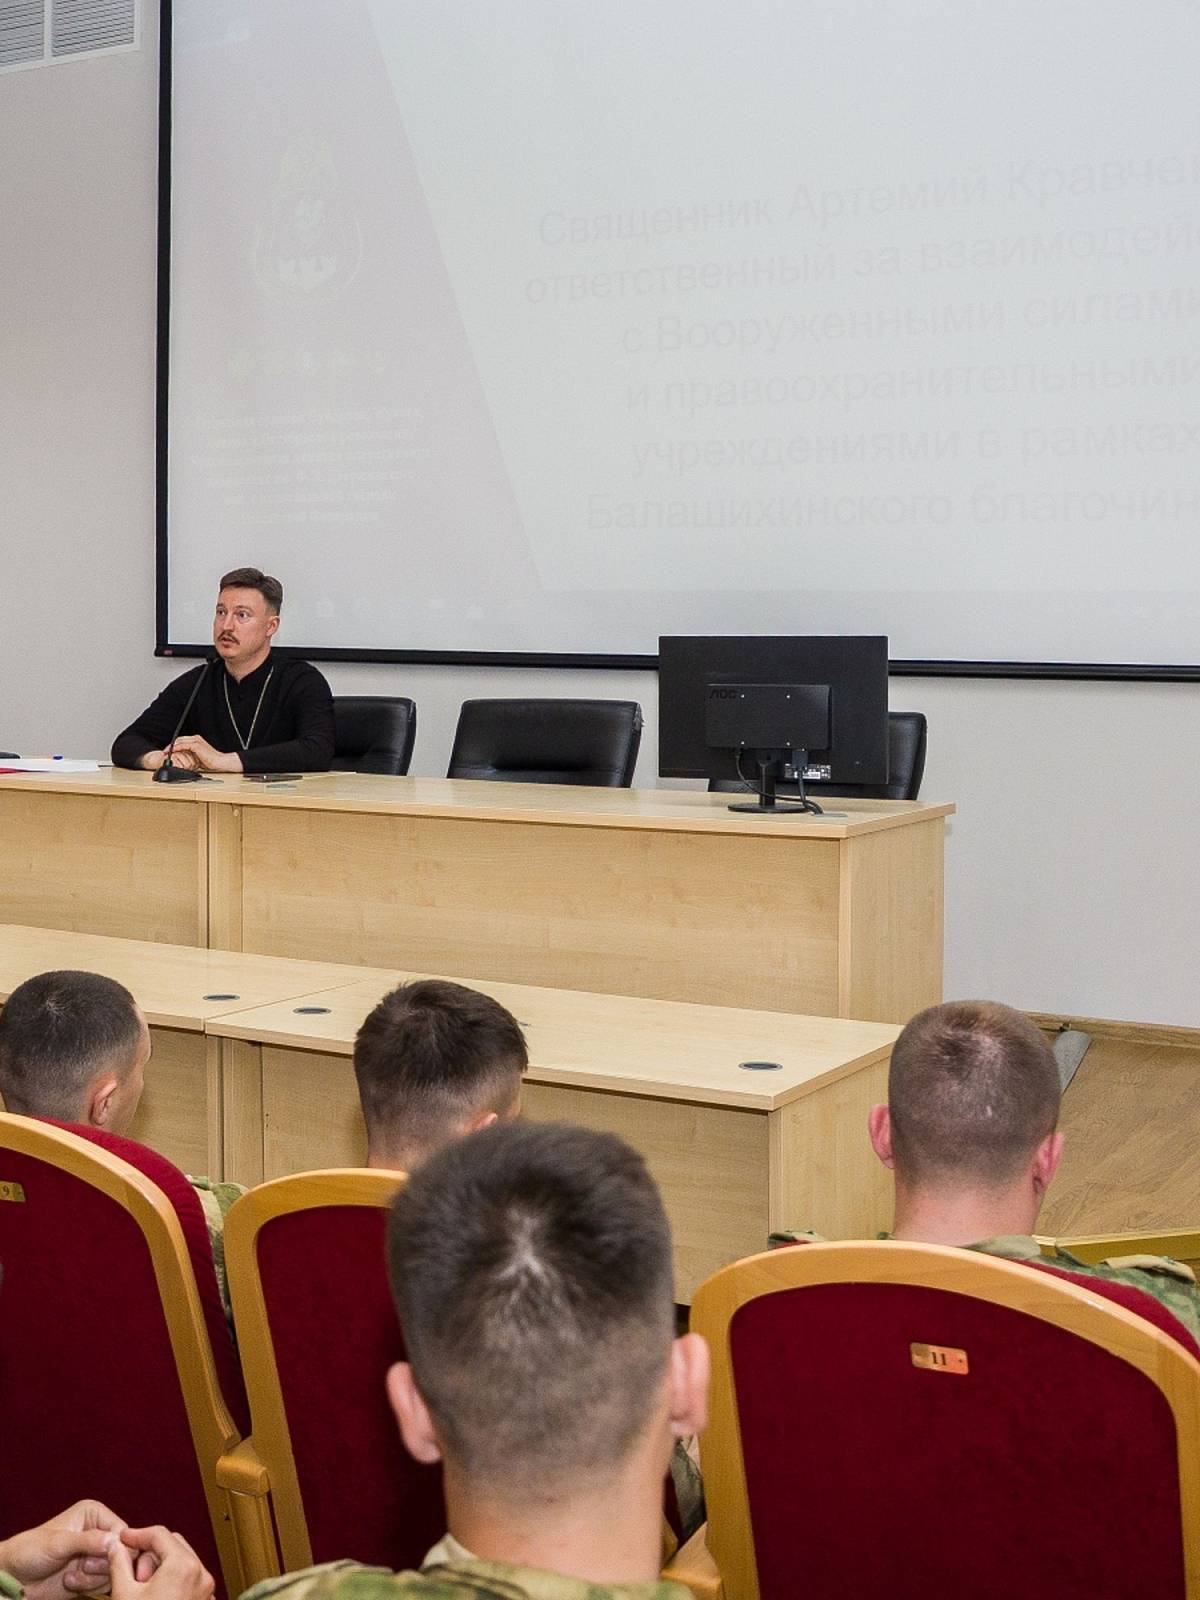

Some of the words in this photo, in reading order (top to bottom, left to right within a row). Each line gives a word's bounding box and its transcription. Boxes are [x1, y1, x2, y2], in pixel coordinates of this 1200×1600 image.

[538, 198, 774, 246] Священник
[787, 163, 987, 230] Артемий
[525, 242, 836, 303] ответственный
[852, 245, 902, 277] за
[920, 211, 1200, 272] взаимодей
[621, 326, 644, 353] с
[657, 300, 1005, 354] Вооруженными
[626, 382, 649, 411] и
[664, 354, 1200, 418] правоохранительными
[631, 429, 961, 478] учреждениями
[977, 428, 1001, 460] в
[1019, 420, 1200, 467] рамках
[587, 493, 952, 530] Балашихинского
[930, 1350, 947, 1366] 11
